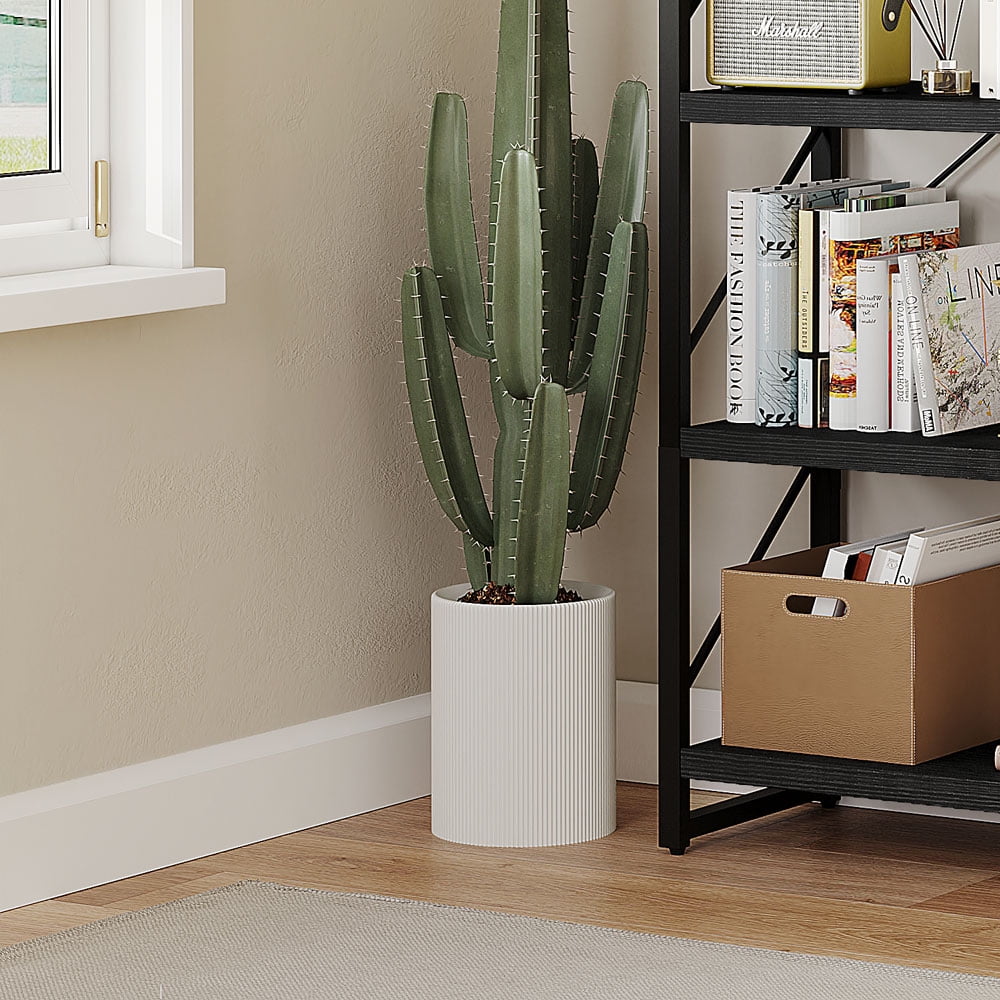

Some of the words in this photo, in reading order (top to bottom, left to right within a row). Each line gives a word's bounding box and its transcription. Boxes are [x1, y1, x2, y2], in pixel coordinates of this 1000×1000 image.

[752, 15, 824, 40] Marshall
[729, 200, 744, 245] THE
[729, 251, 744, 348] FASHION
[905, 295, 920, 315] ON
[938, 296, 949, 305] ON
[801, 308, 809, 349] OUTSIDERS
[909, 319, 925, 350] LINE
[728, 354, 744, 416] BOOK
[922, 410, 935, 432] MoMA
